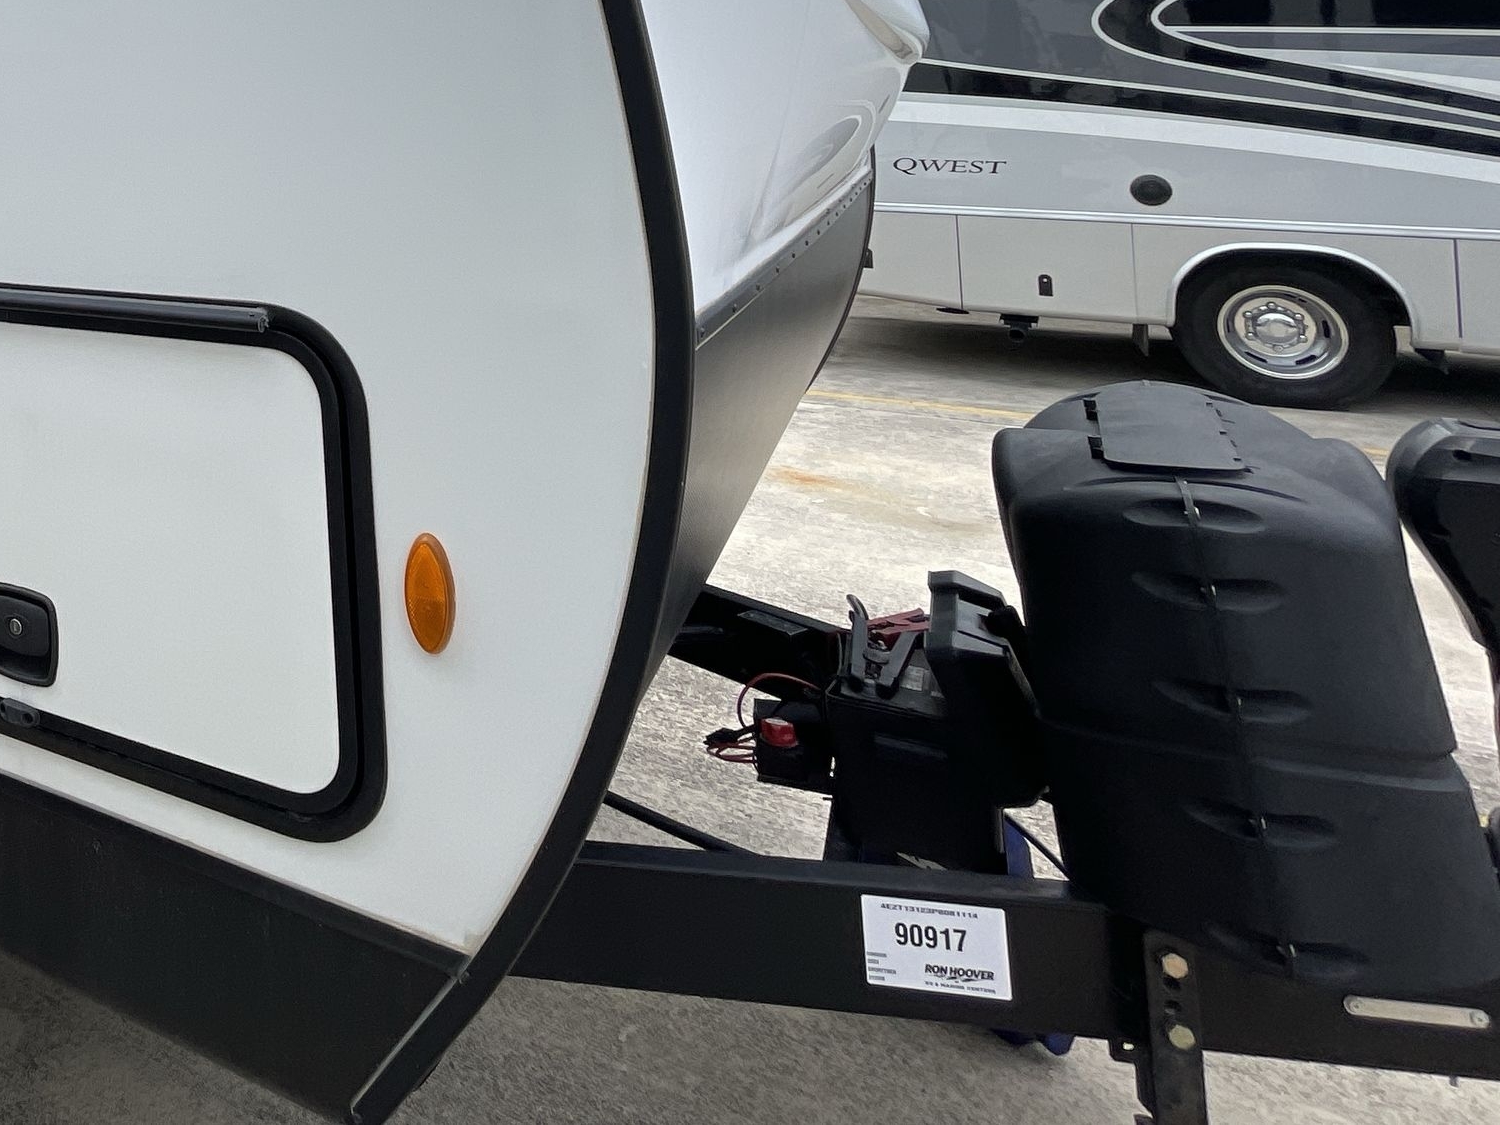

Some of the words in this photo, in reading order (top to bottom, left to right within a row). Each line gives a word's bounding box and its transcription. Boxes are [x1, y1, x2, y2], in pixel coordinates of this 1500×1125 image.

[893, 157, 1007, 175] QWEST
[894, 922, 967, 952] 90917
[924, 964, 948, 976] RON
[949, 966, 995, 981] HOOVER
